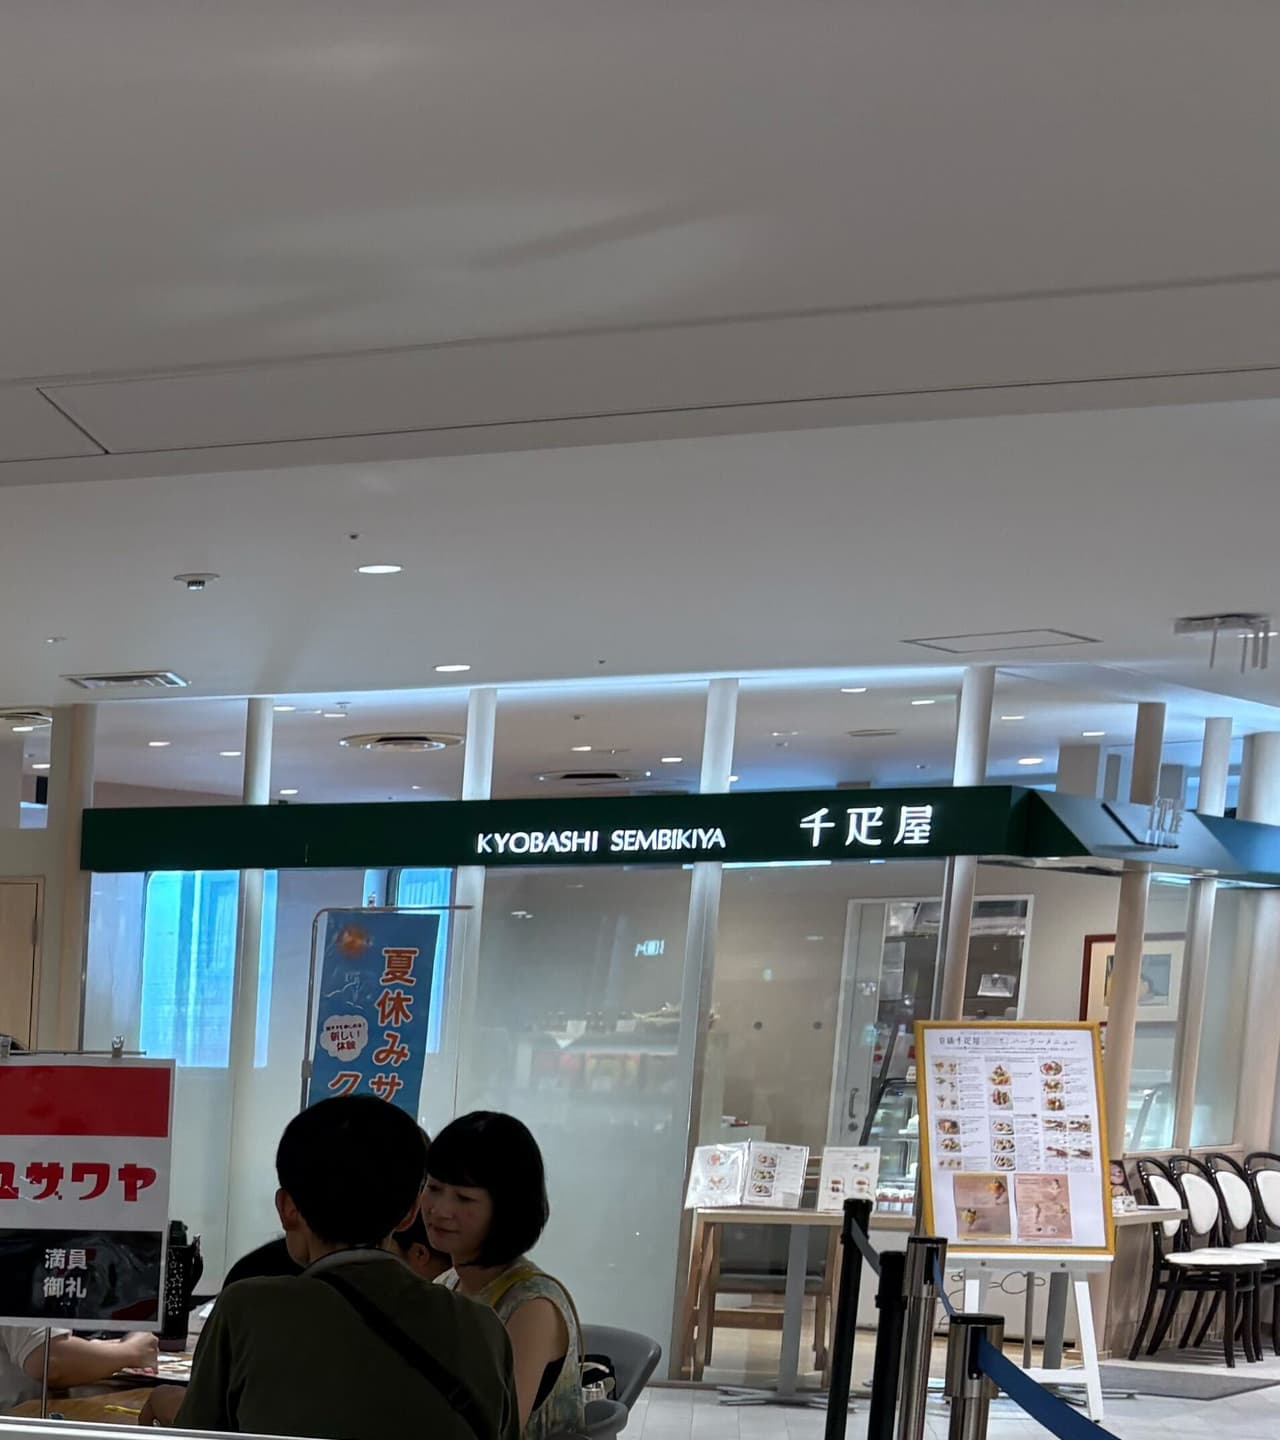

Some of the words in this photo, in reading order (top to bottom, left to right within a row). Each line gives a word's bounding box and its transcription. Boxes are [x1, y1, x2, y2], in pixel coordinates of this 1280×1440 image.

[799, 805, 933, 848] 千疋屋
[477, 831, 598, 854] KYOBASHI
[611, 828, 726, 852] SEMBIKIYA
[44, 1248, 88, 1271] 満員
[43, 1276, 88, 1299] 御礼
